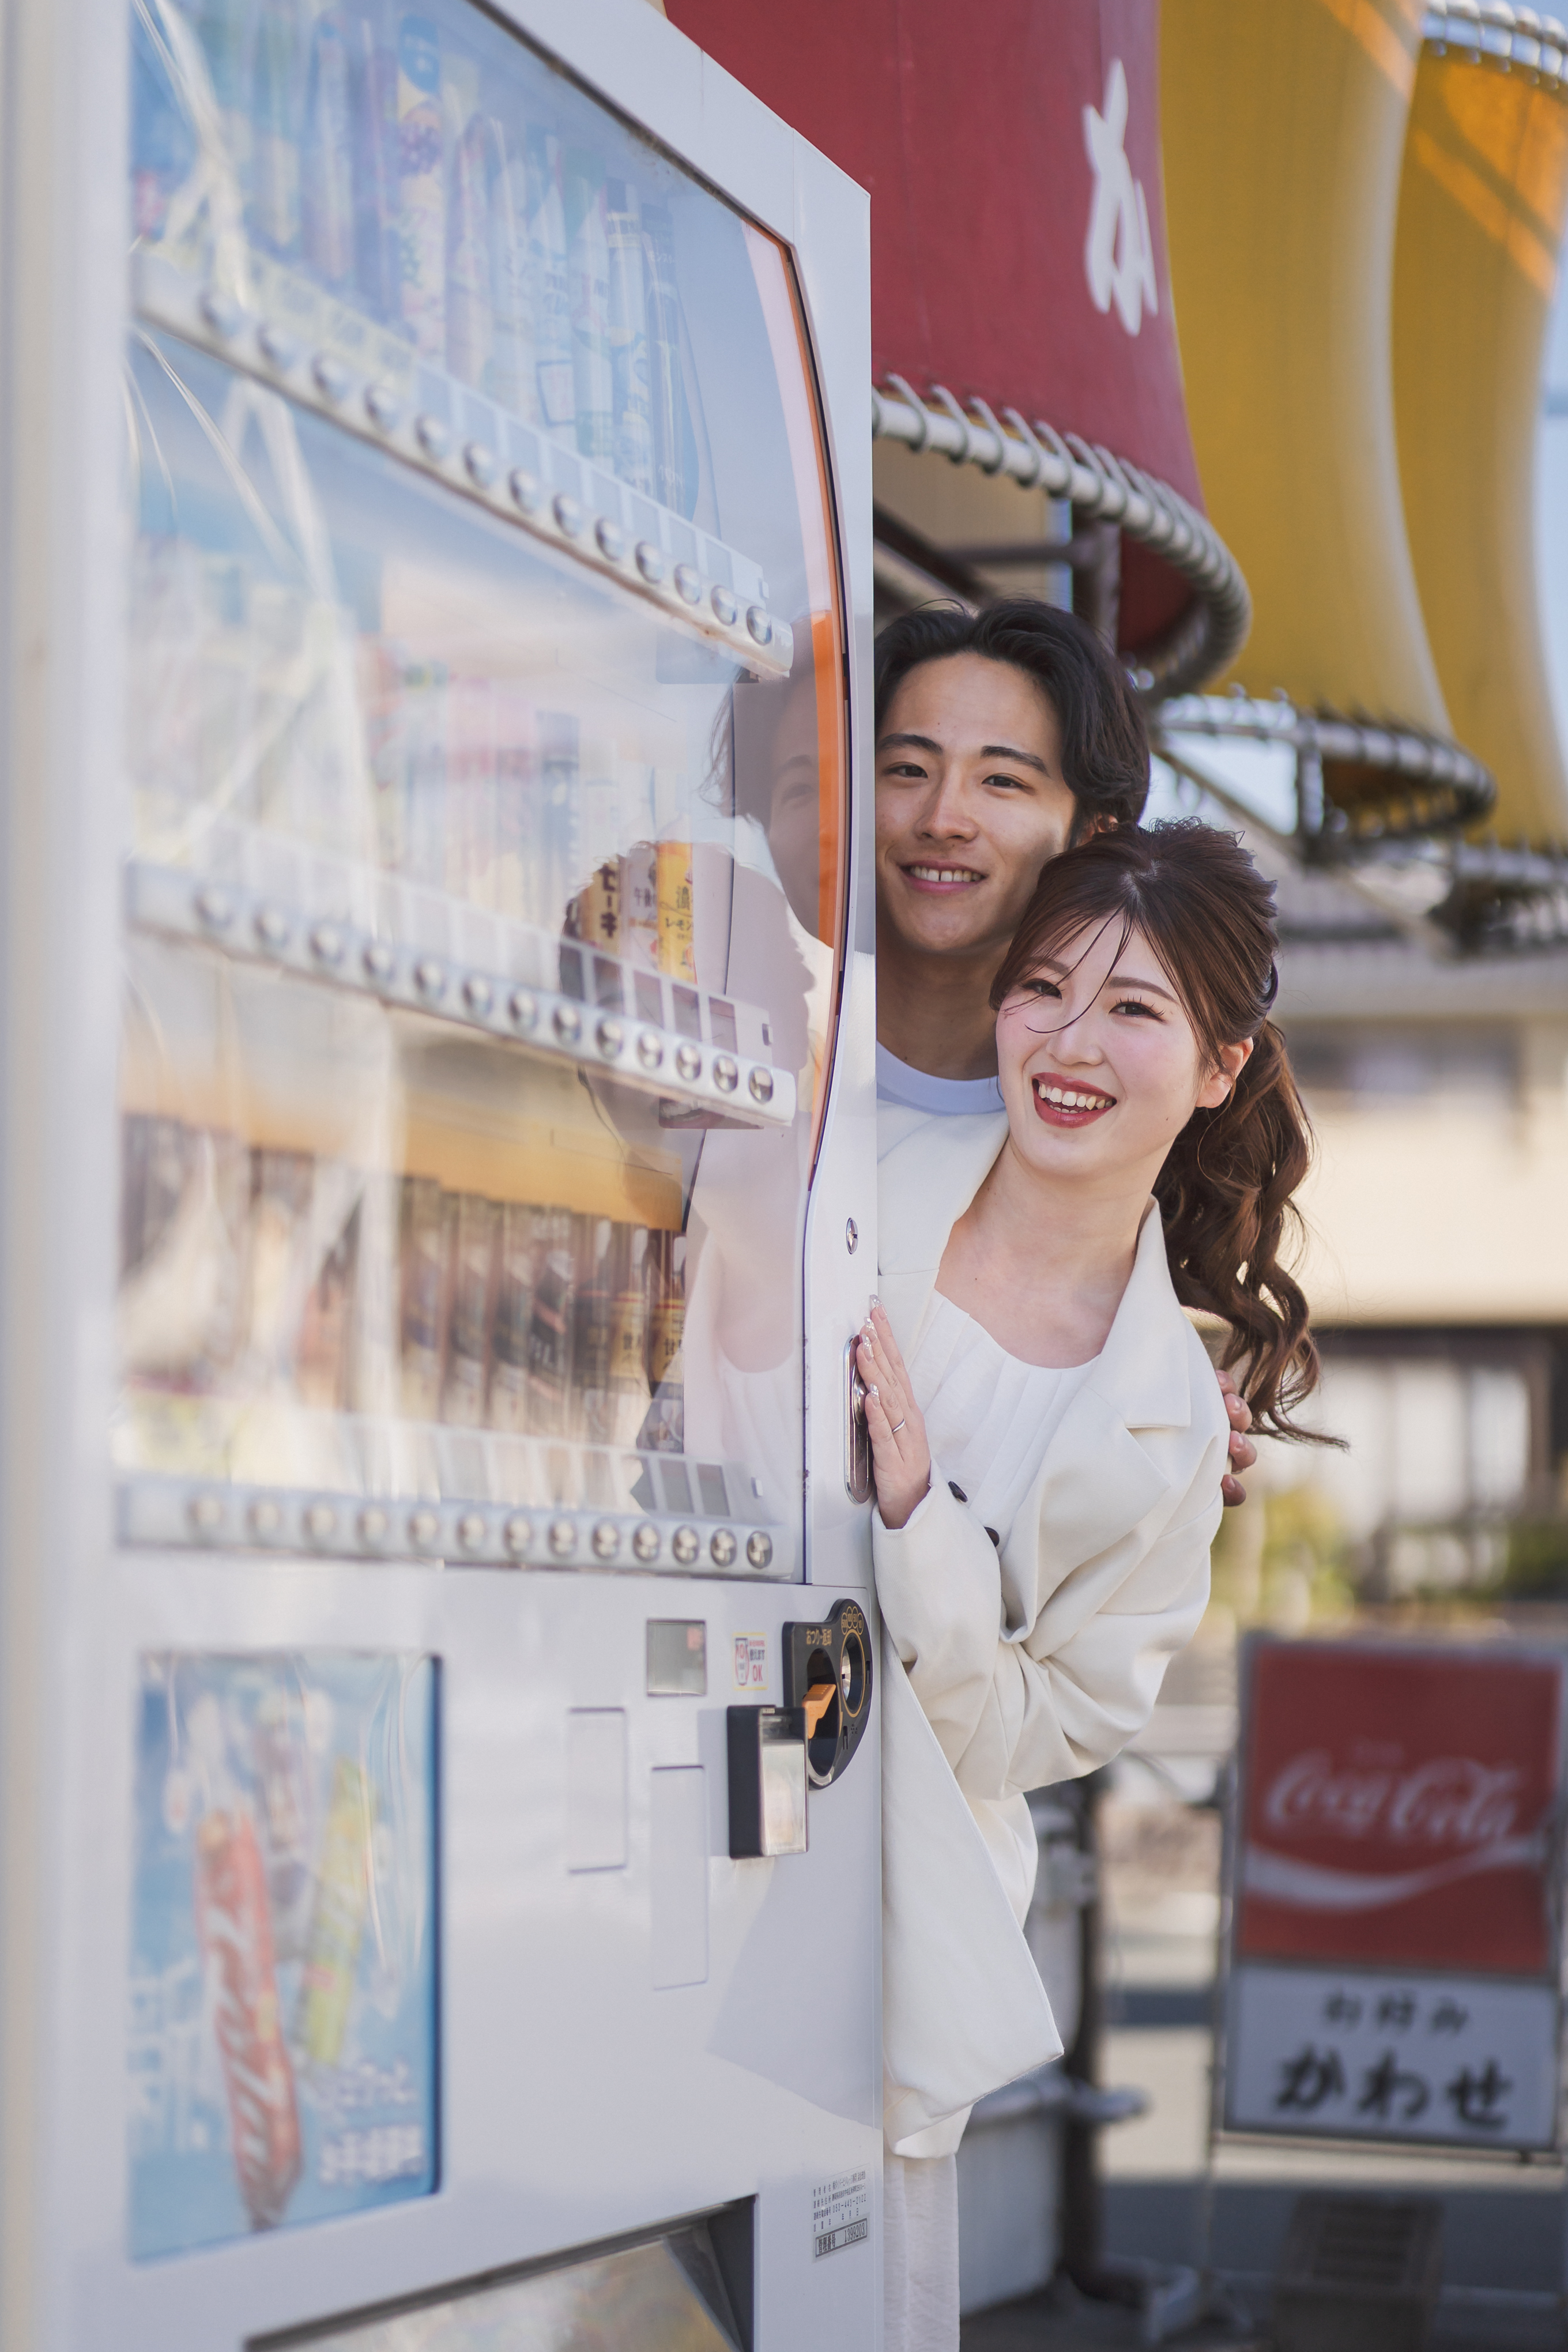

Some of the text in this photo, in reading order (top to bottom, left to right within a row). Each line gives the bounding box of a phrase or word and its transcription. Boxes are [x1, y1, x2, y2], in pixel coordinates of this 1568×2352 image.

[752, 1664, 763, 1682] OK
[1273, 2042, 1514, 2128] かわせ
[832, 2193, 866, 2213] 053-443-2122
[818, 2222, 865, 2254] 管理番号 1399203
